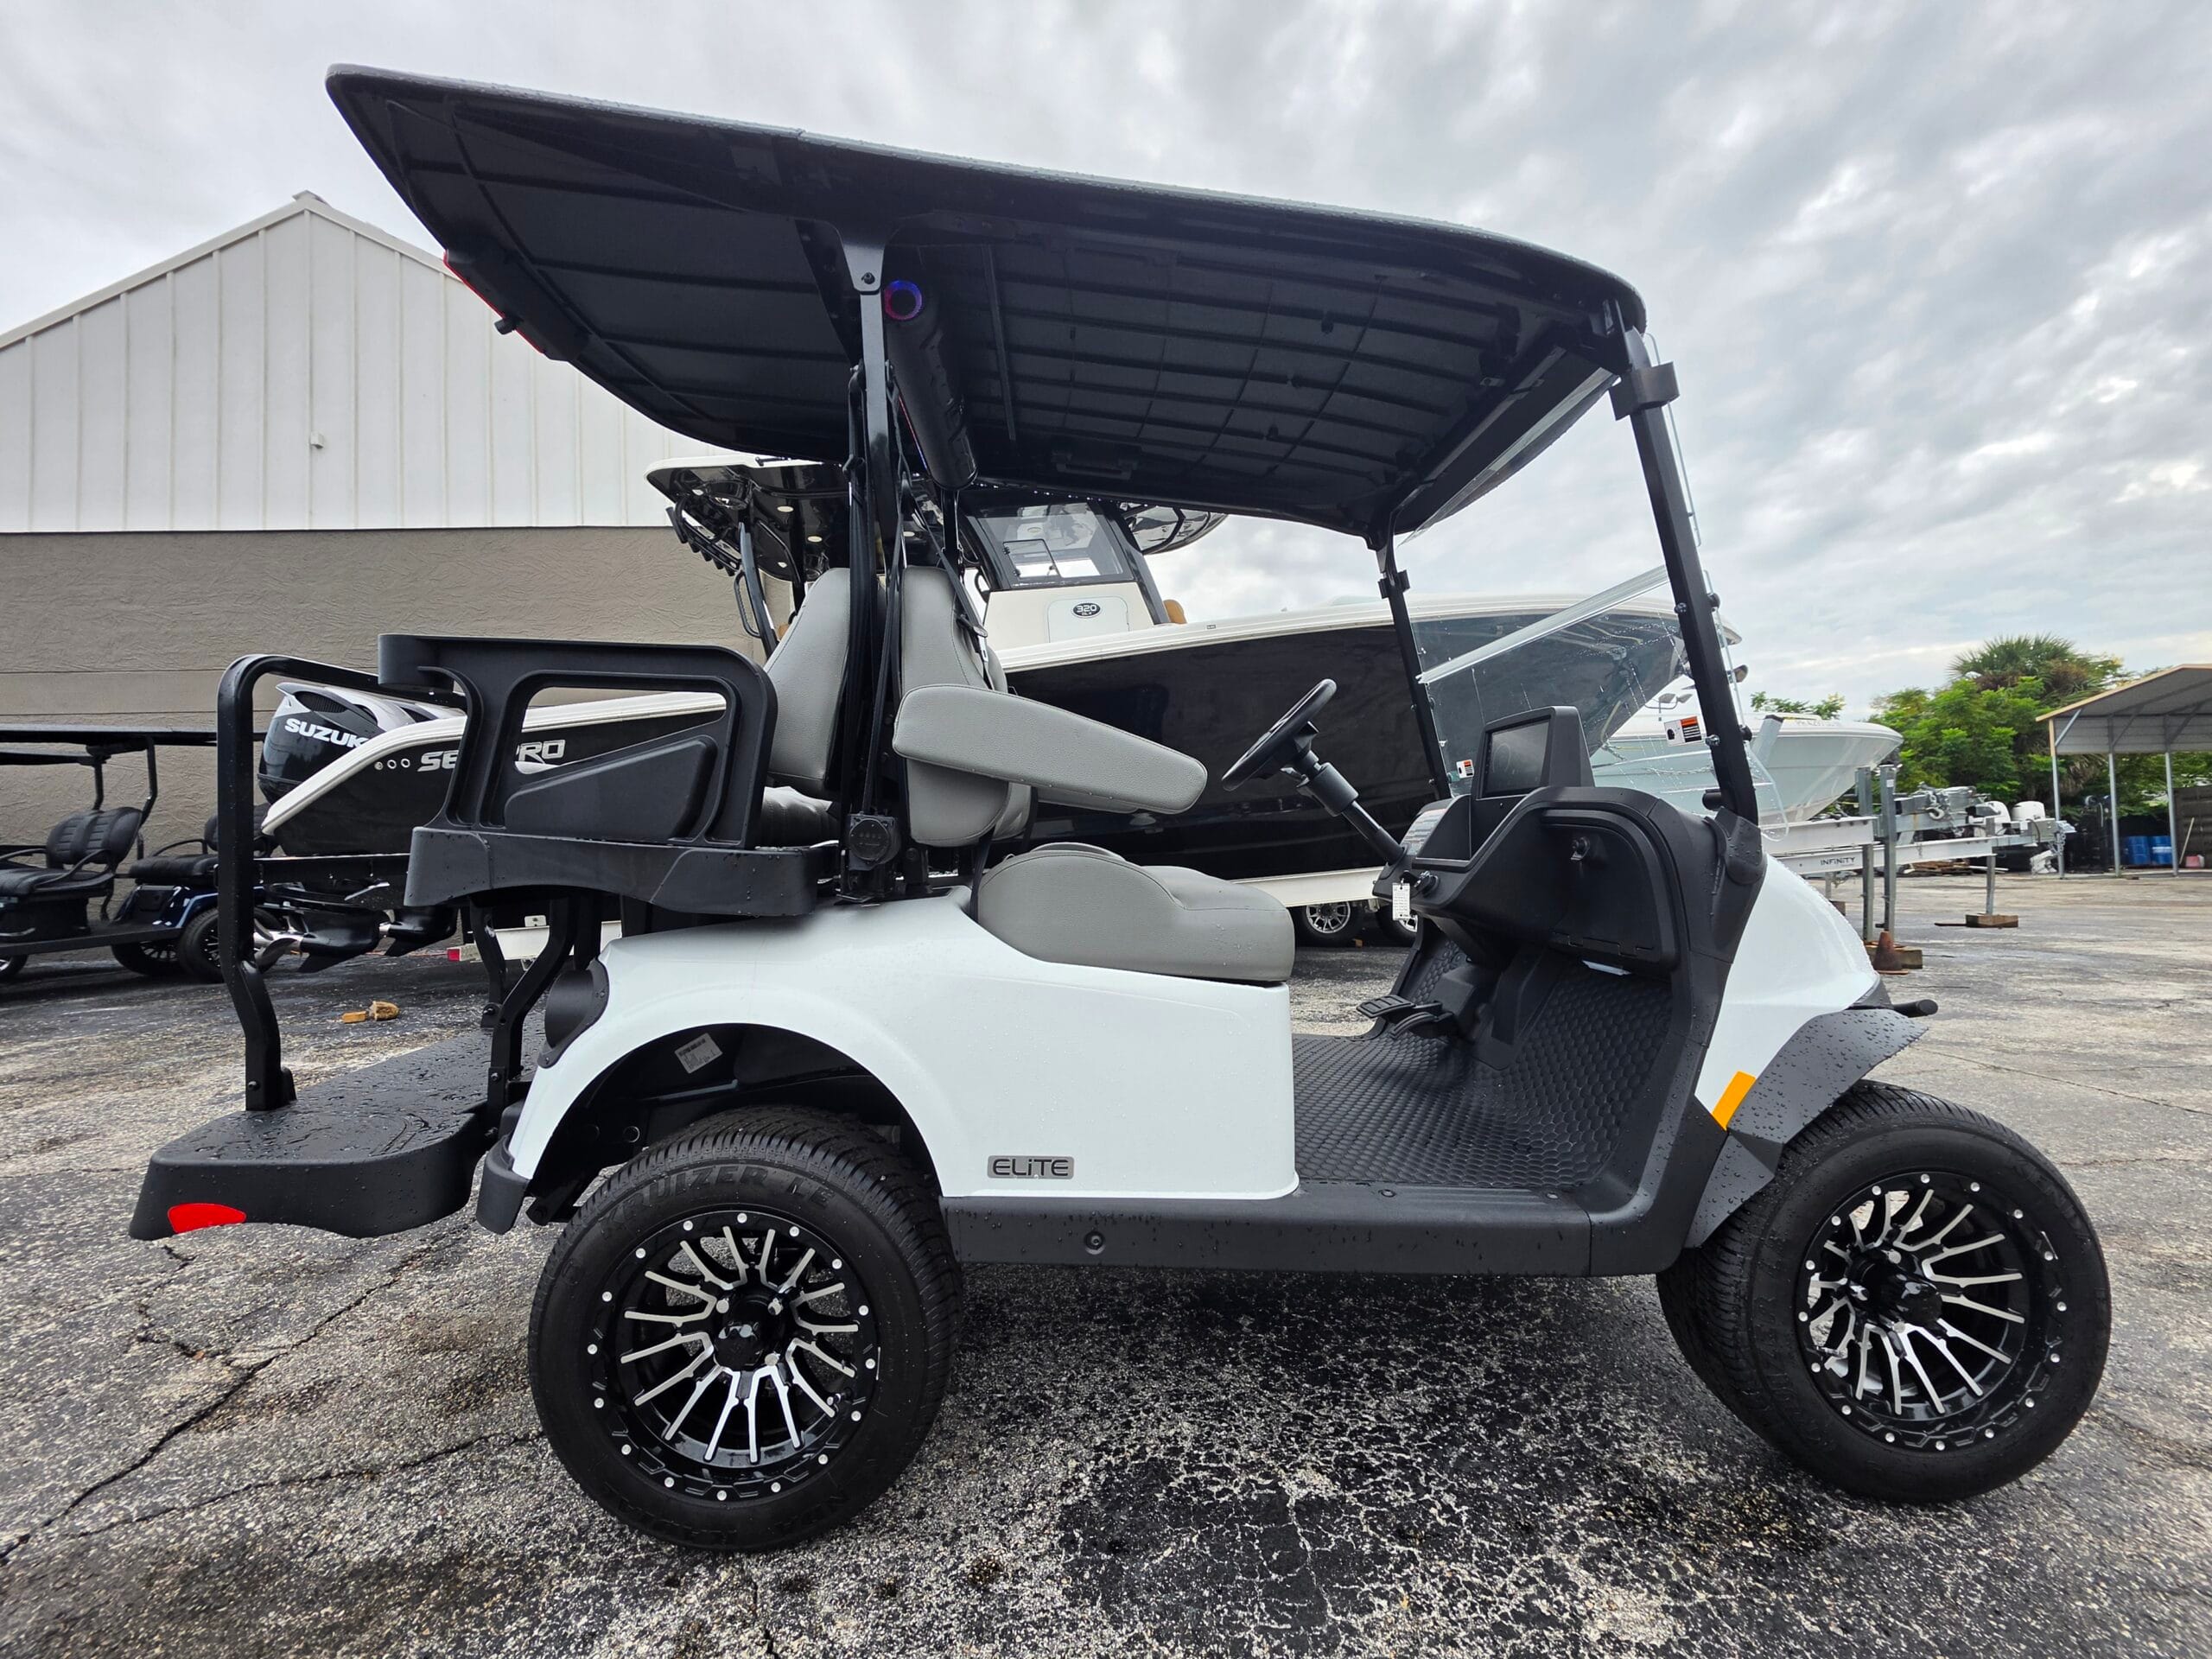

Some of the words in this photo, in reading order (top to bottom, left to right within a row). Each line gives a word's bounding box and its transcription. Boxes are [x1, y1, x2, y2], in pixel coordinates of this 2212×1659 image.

[284, 718, 370, 748] SUZUK
[416, 750, 460, 772] SE
[516, 739, 566, 765] RO
